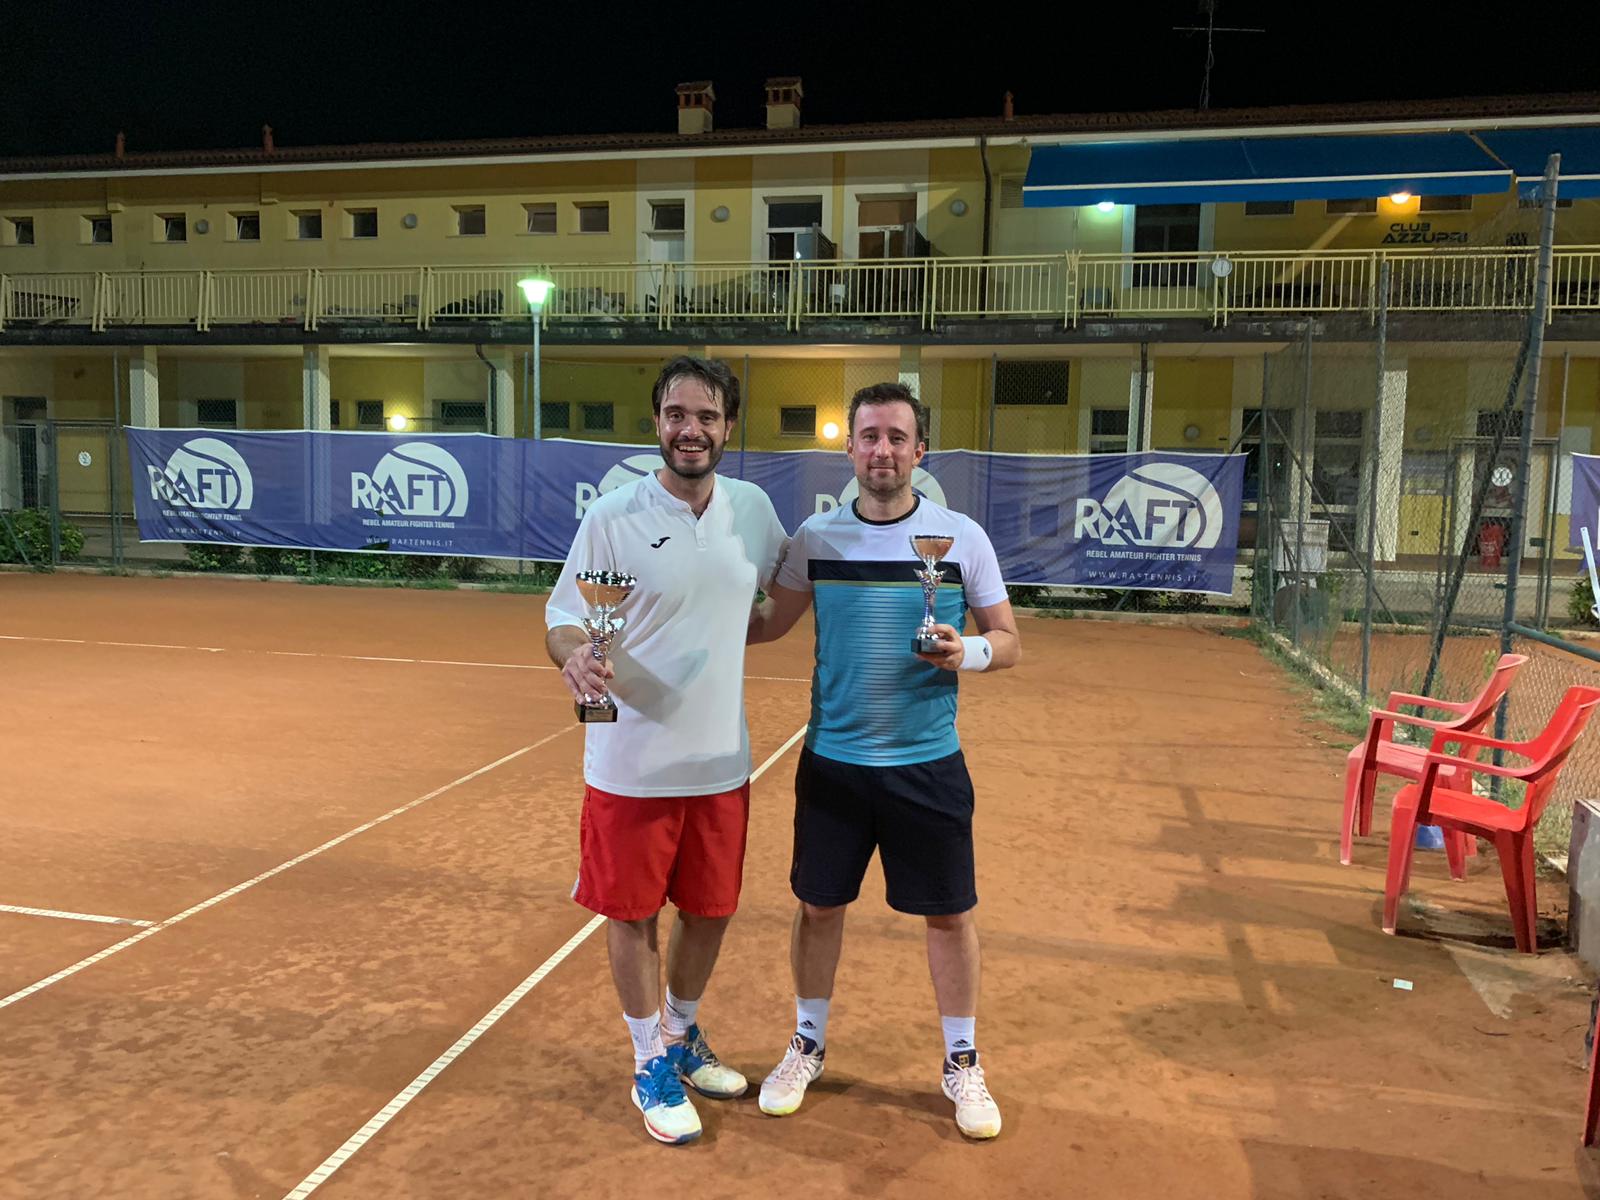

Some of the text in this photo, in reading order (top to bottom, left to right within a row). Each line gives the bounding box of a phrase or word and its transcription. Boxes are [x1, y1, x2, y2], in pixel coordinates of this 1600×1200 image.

[1390, 222, 1431, 232] CLUB
[147, 465, 232, 504] RAFT
[351, 471, 447, 511] RAFT
[362, 519, 455, 529] REBEL AMATEUR FIGHTER TENNIS
[1073, 498, 1198, 542] RAFT
[1086, 550, 1201, 562] REBEL AMATEUR FIGHTER TENNIS
